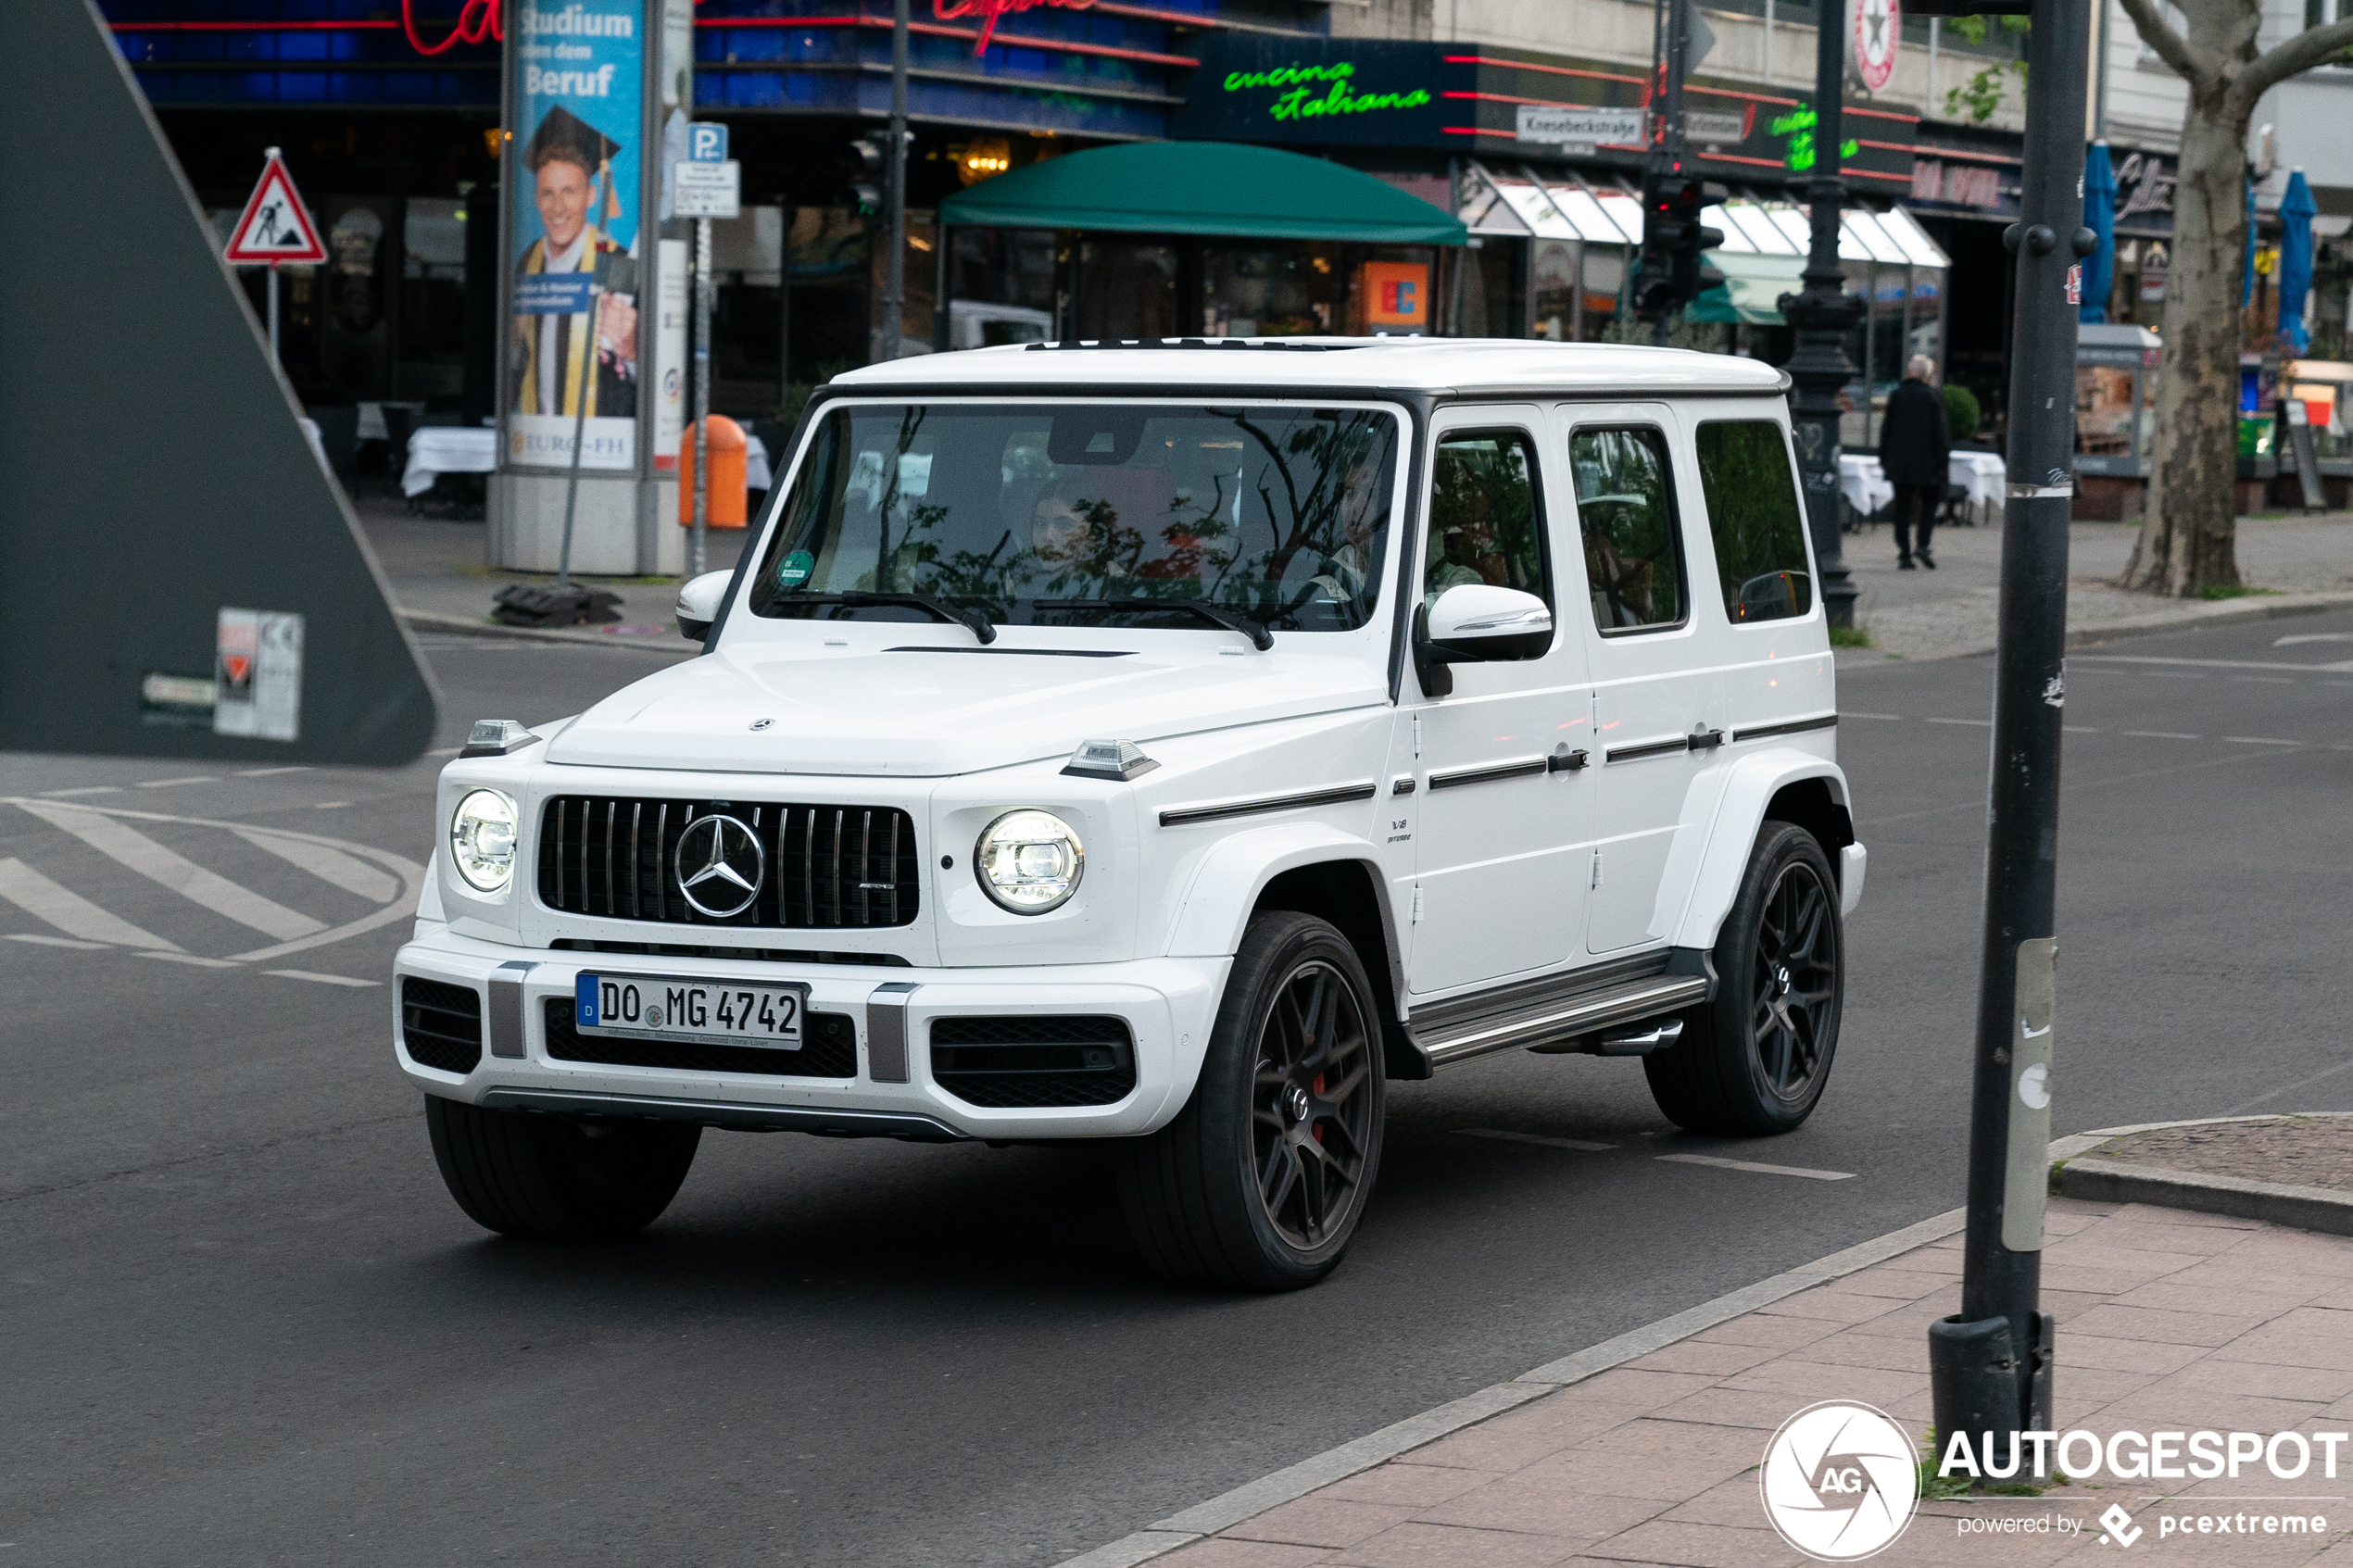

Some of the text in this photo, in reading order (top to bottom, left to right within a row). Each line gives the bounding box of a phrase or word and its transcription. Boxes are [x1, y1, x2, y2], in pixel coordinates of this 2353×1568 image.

[522, 4, 634, 38] Studium
[526, 64, 615, 97] Beruf
[1224, 61, 1354, 92] cucina
[1269, 79, 1431, 120] italiana
[696, 130, 718, 159] P
[1381, 281, 1416, 314] EC
[1392, 819, 1407, 830] V8
[585, 1006, 593, 1017] D
[602, 982, 798, 1035] DO MG 4742
